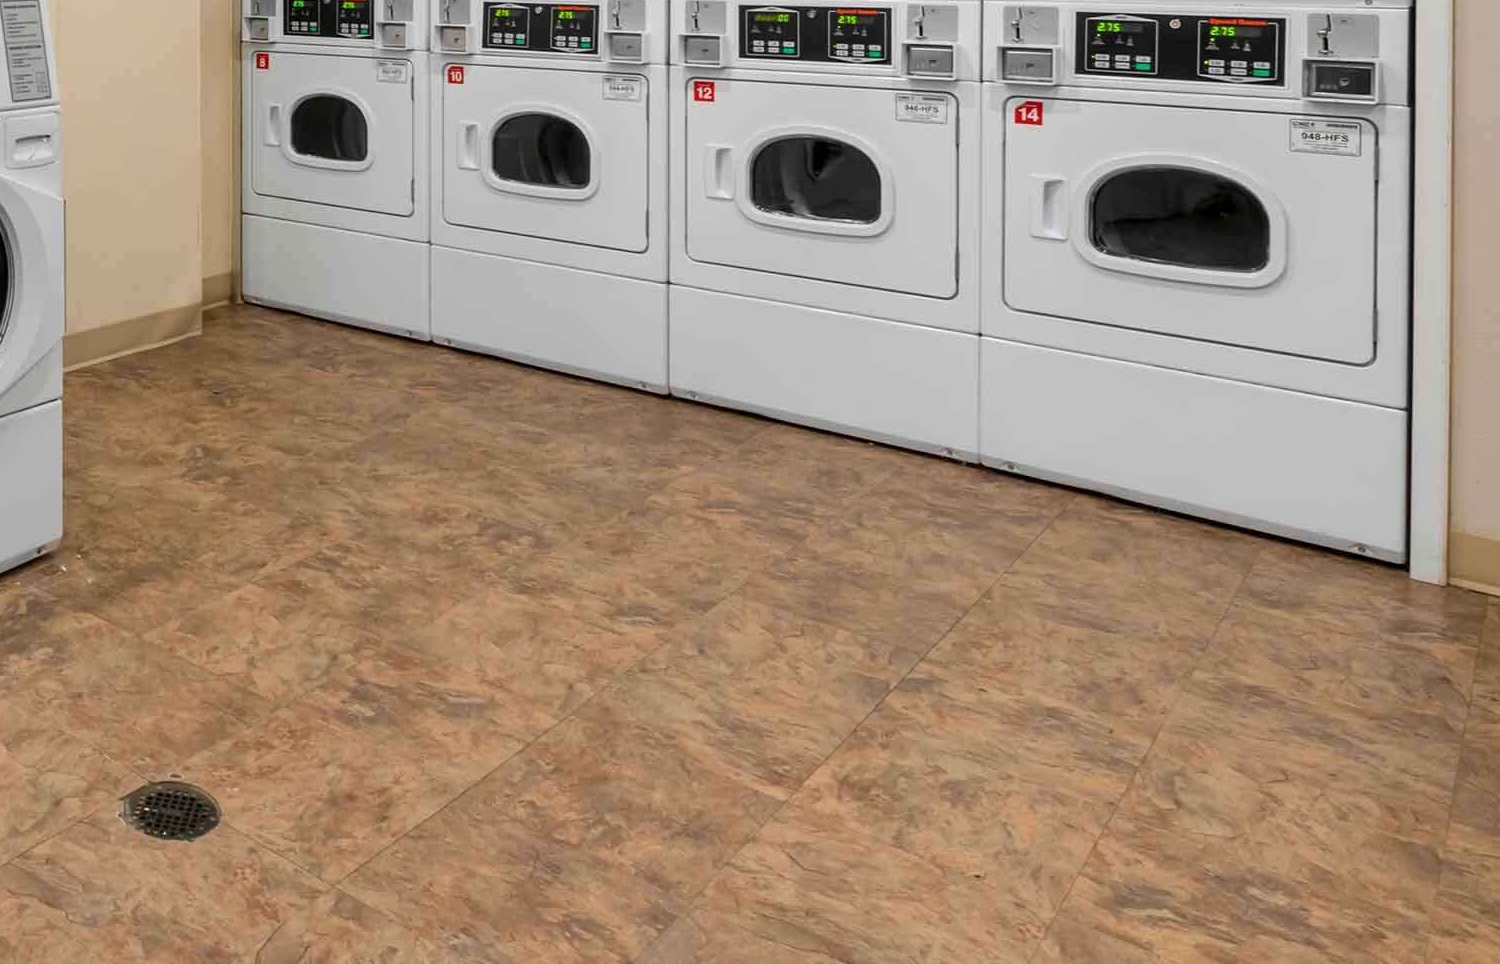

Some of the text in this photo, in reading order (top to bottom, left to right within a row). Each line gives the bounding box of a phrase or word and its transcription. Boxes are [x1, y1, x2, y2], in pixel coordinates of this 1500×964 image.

[260, 58, 266, 67] 8
[451, 72, 462, 82] 10
[698, 88, 712, 99] 12
[1016, 108, 1040, 122] 14
[1302, 132, 1349, 143] 948-HFS
